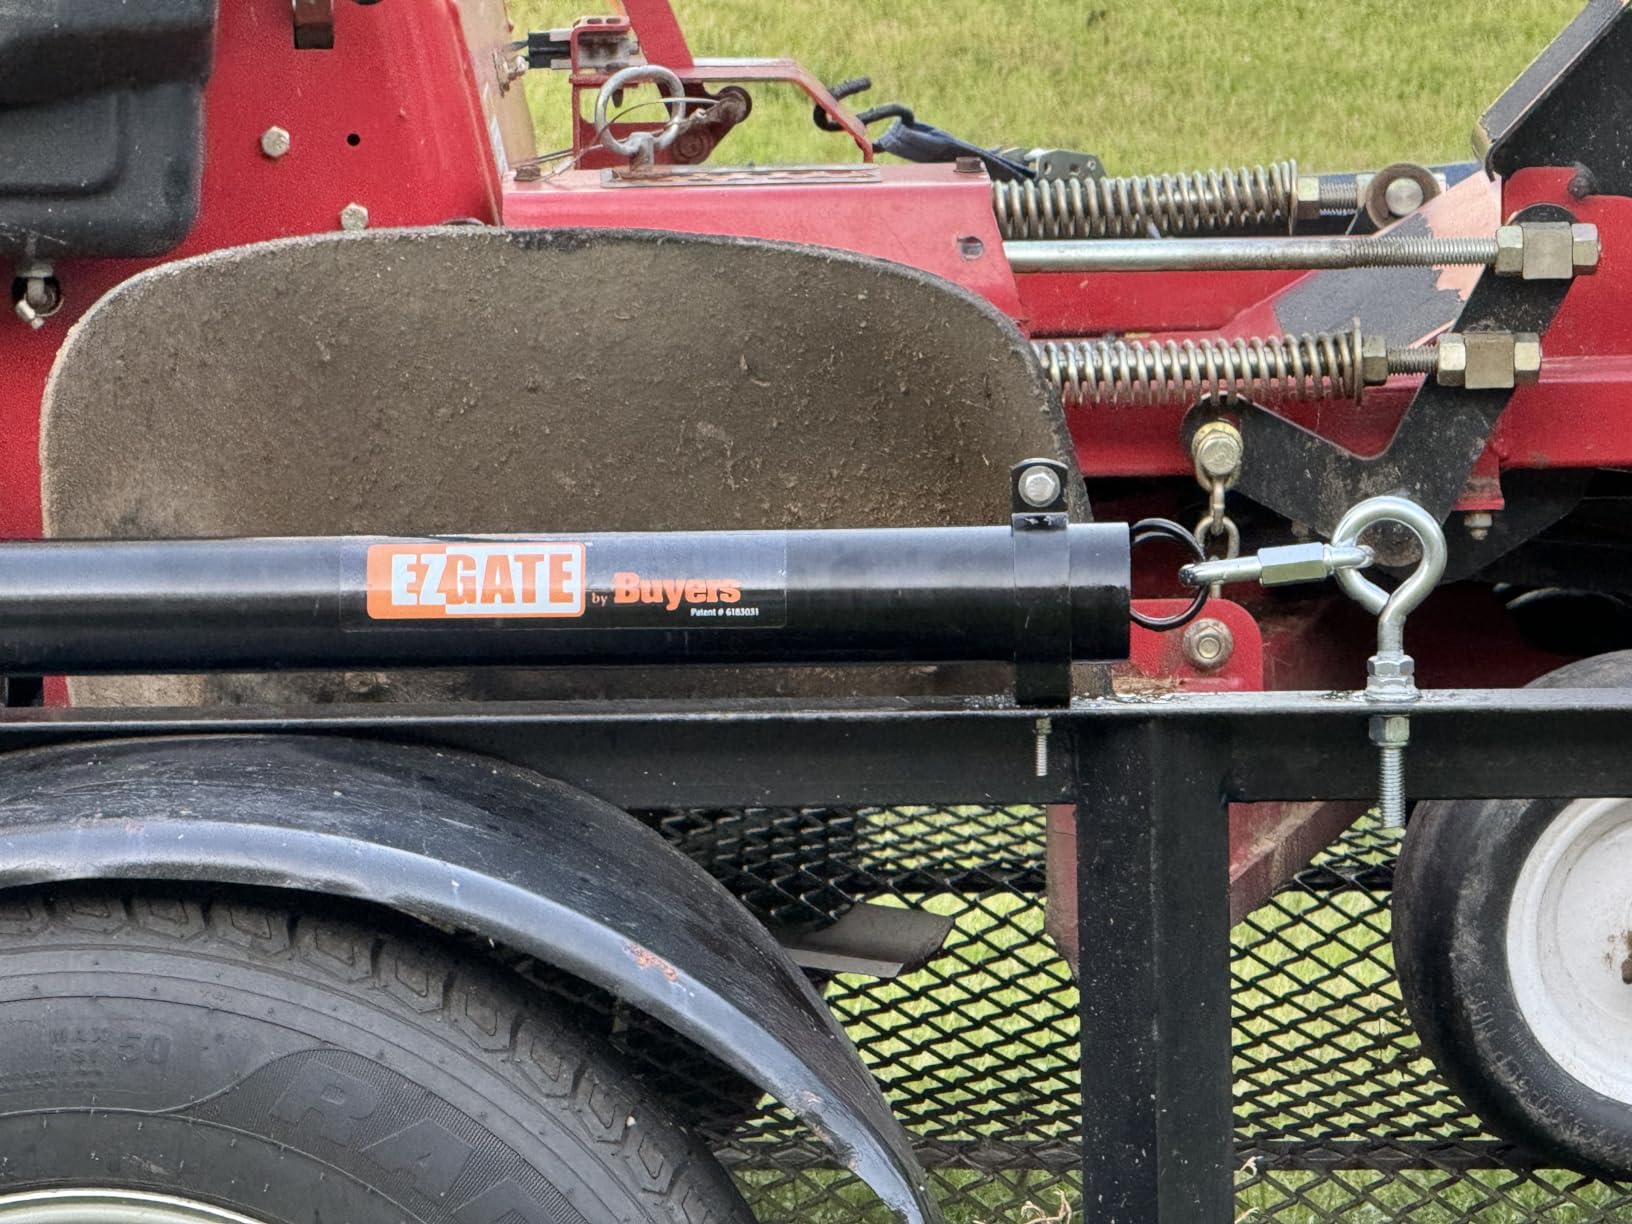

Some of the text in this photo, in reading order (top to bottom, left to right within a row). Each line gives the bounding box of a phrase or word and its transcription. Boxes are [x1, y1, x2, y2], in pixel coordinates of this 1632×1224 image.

[391, 553, 742, 612] EZGATE by Buyers
[690, 607, 717, 617] Patent
[117, 1030, 174, 1066] 50
